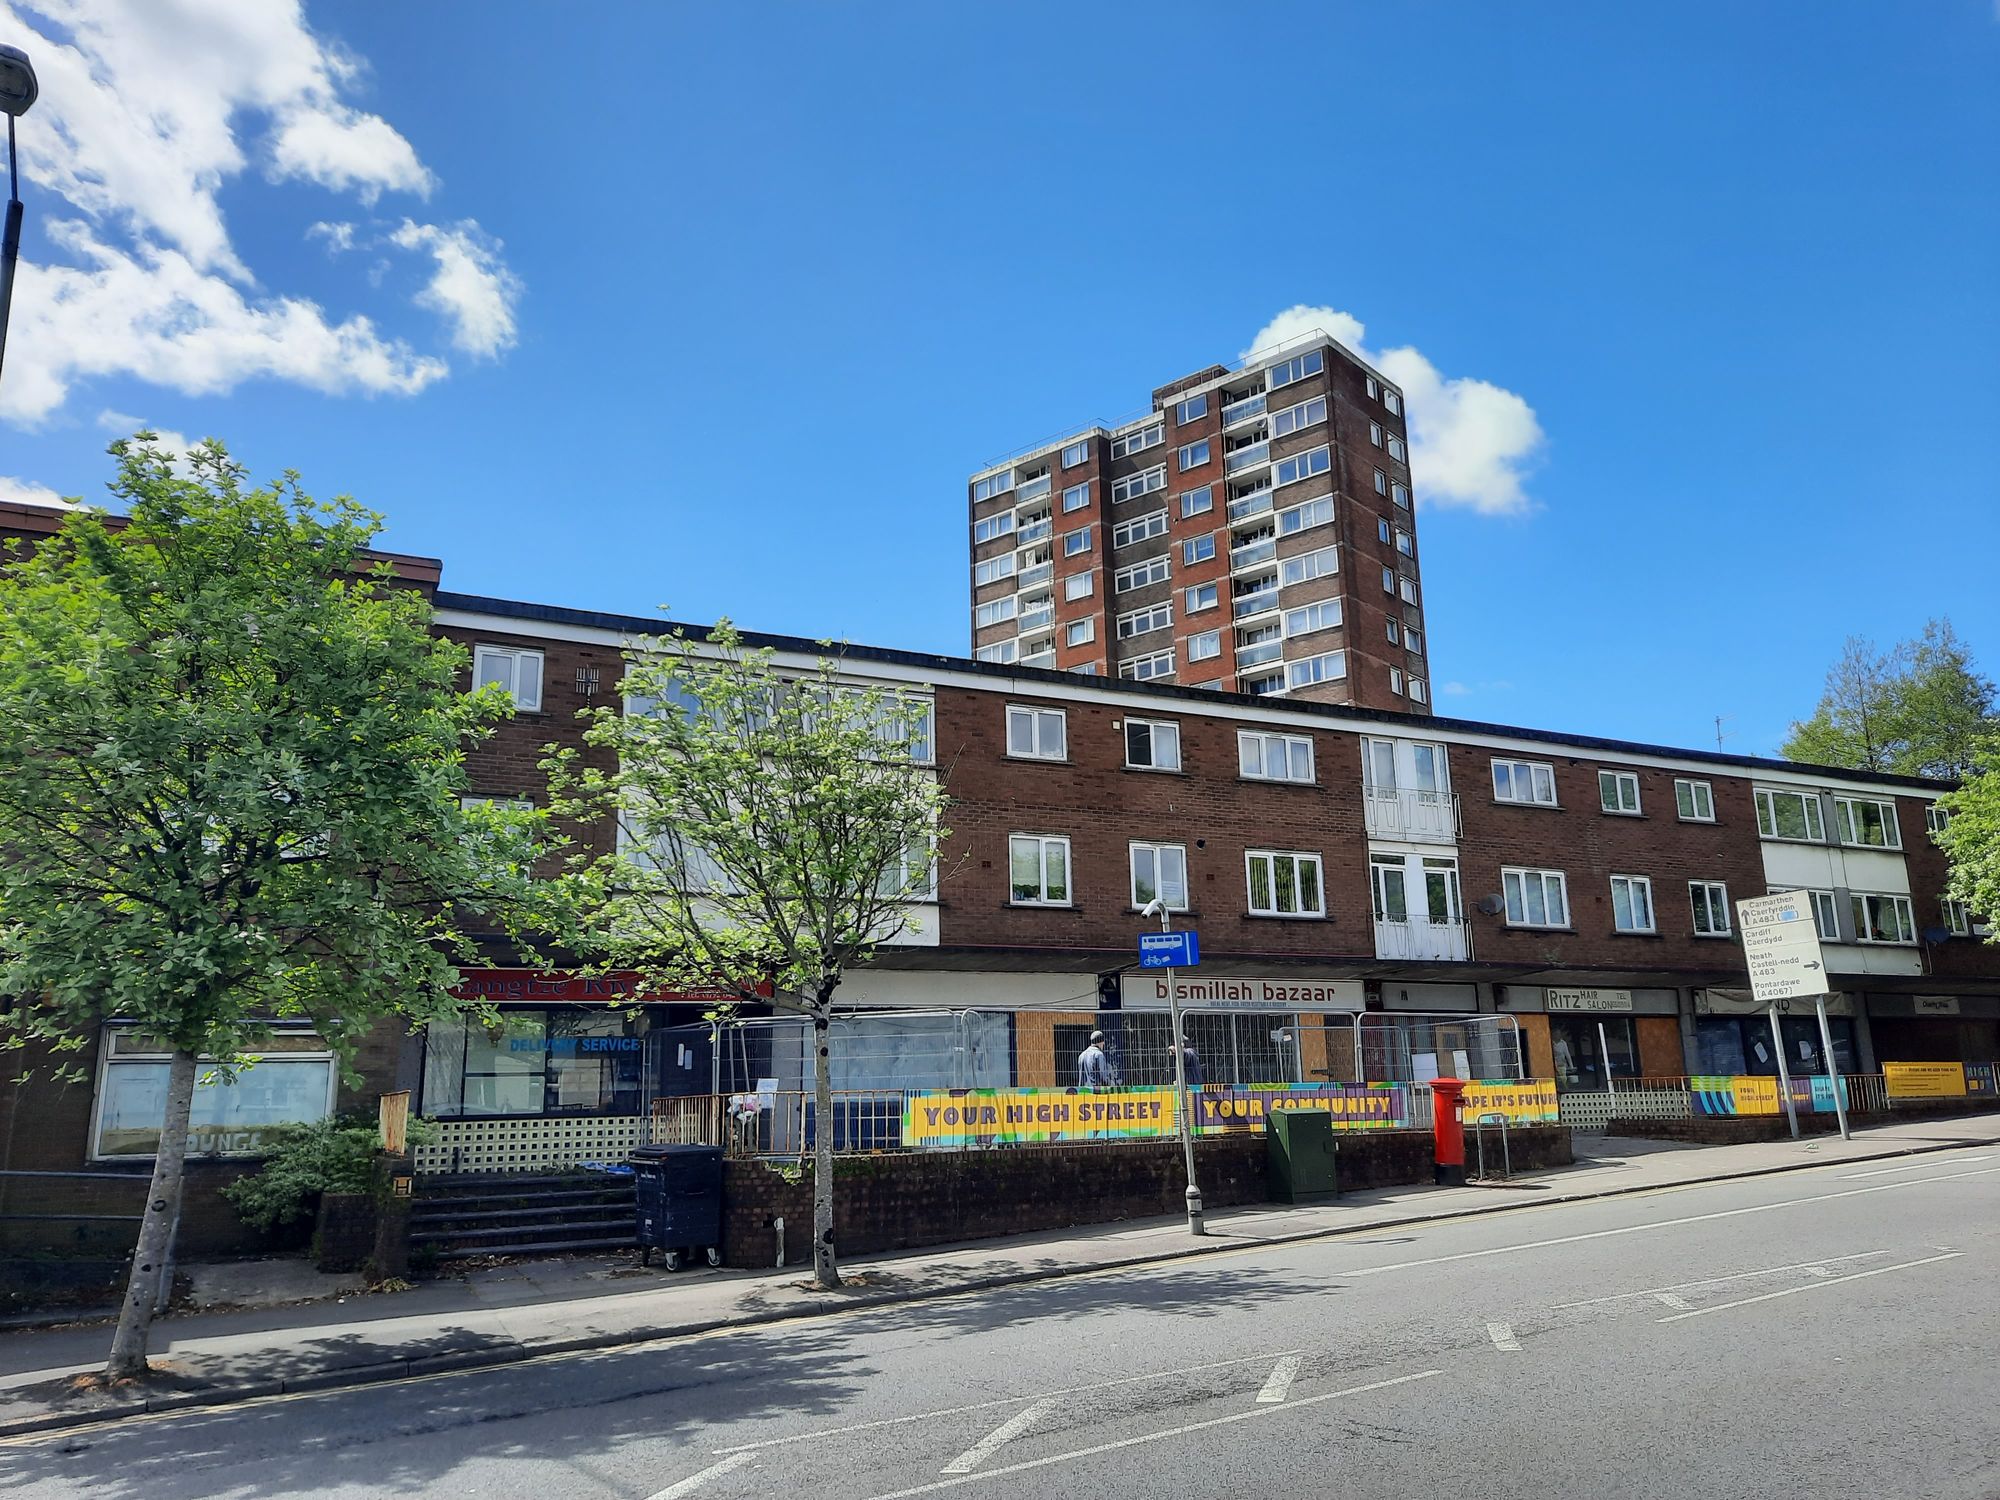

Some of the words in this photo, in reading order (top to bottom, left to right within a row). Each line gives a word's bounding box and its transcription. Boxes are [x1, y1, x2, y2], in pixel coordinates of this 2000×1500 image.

[1749, 897, 1794, 909] Carmarthen
[1751, 905, 1795, 917] Caerfyrddin
[1746, 929, 1771, 938] Cardiff
[1747, 936, 1783, 946] Caerdydd
[1750, 952, 1773, 960] Neath
[459, 974, 567, 999] angtze
[1755, 979, 1801, 989] Pontardawe
[1156, 980, 1252, 1001] bsmillah
[1263, 983, 1335, 1002] bazaar
[1550, 990, 1581, 1009] RITZ
[1580, 991, 1598, 999] HAIR
[1587, 1000, 1613, 1010] SALON
[510, 1039, 577, 1051] DELIVY
[582, 1038, 640, 1052] SERVICE
[1203, 1099, 1265, 1119] YOUR
[1270, 1096, 1391, 1115] COMMUNITY
[1464, 1095, 1488, 1109] APE
[1491, 1095, 1515, 1107] IT'S
[924, 1106, 997, 1126] YOUR
[1006, 1103, 1070, 1124] HIGH
[1078, 1101, 1161, 1121] STREET
